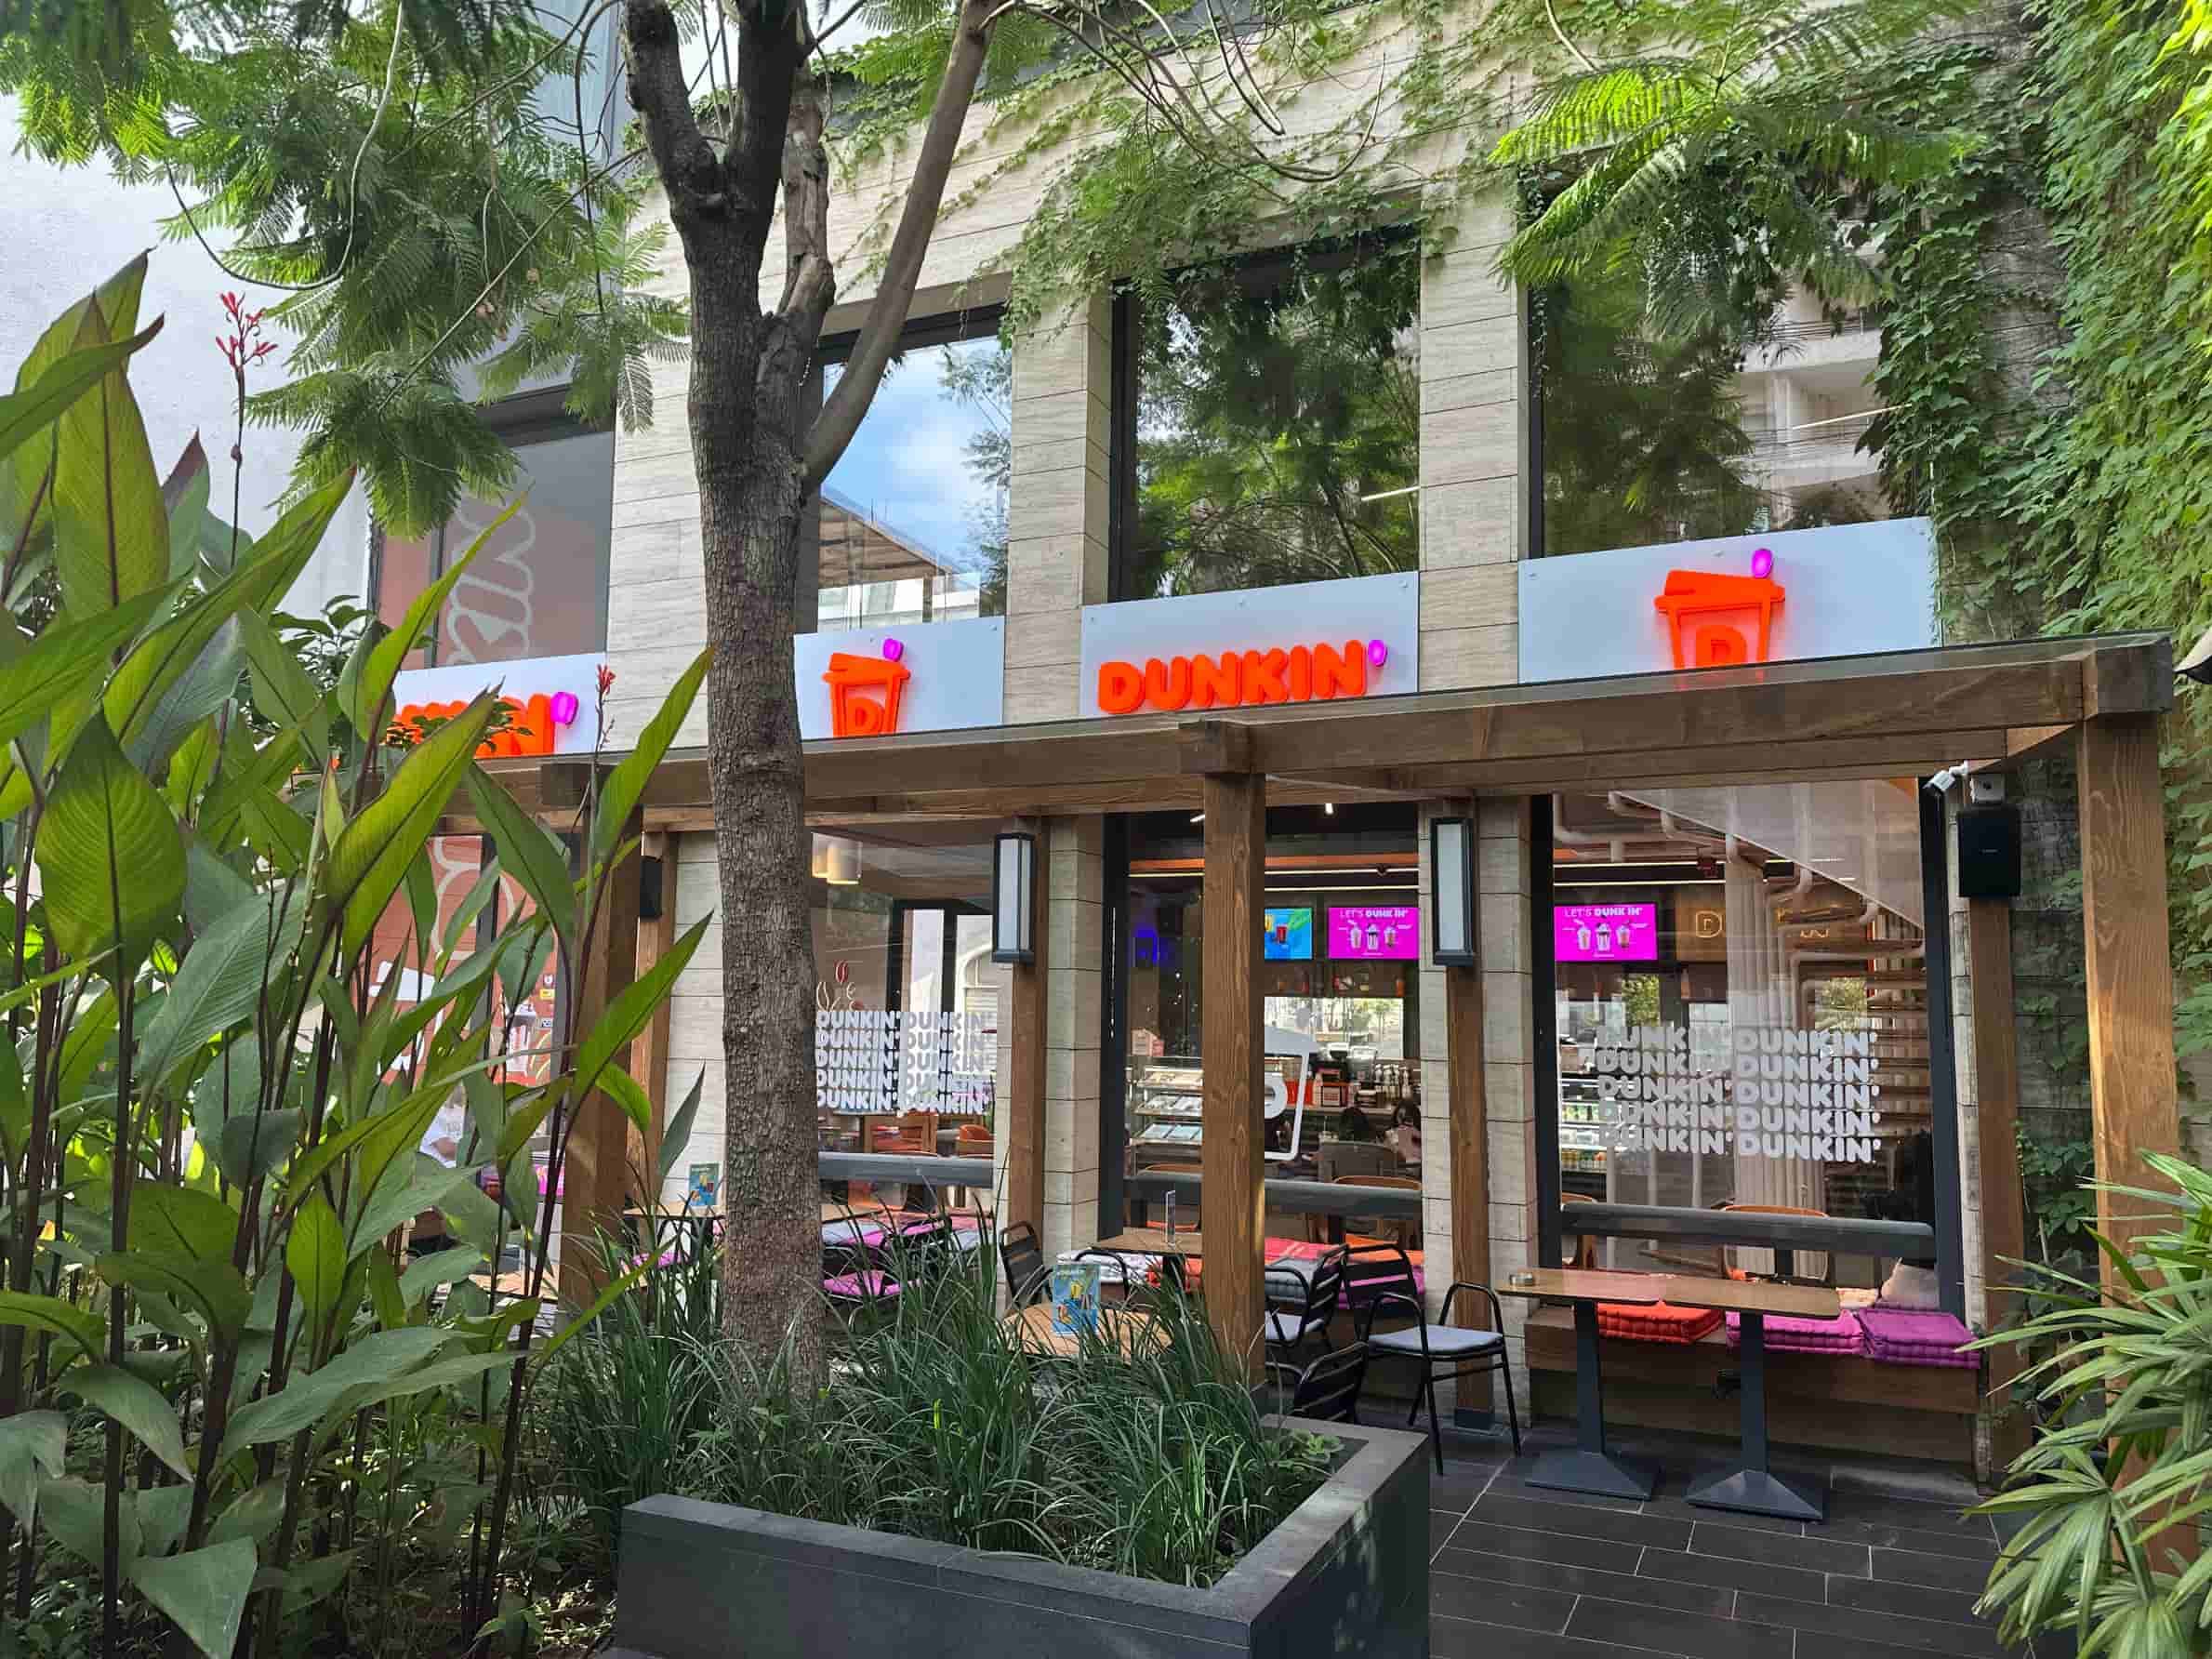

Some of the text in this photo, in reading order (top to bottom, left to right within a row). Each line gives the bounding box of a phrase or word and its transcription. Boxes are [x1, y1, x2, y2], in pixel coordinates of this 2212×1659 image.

[1695, 624, 1748, 668] D
[1098, 640, 1388, 714] DUNKIN'
[846, 697, 884, 736] D
[1563, 908, 1592, 917] LET'S
[1594, 908, 1624, 917] DUNK
[1737, 1054, 1879, 1083] DUNKIN'
[1737, 1080, 1880, 1109] DUNKIN'
[1738, 1106, 1881, 1136] DUNKIN'
[1739, 1131, 1882, 1162] DUNKIN'
